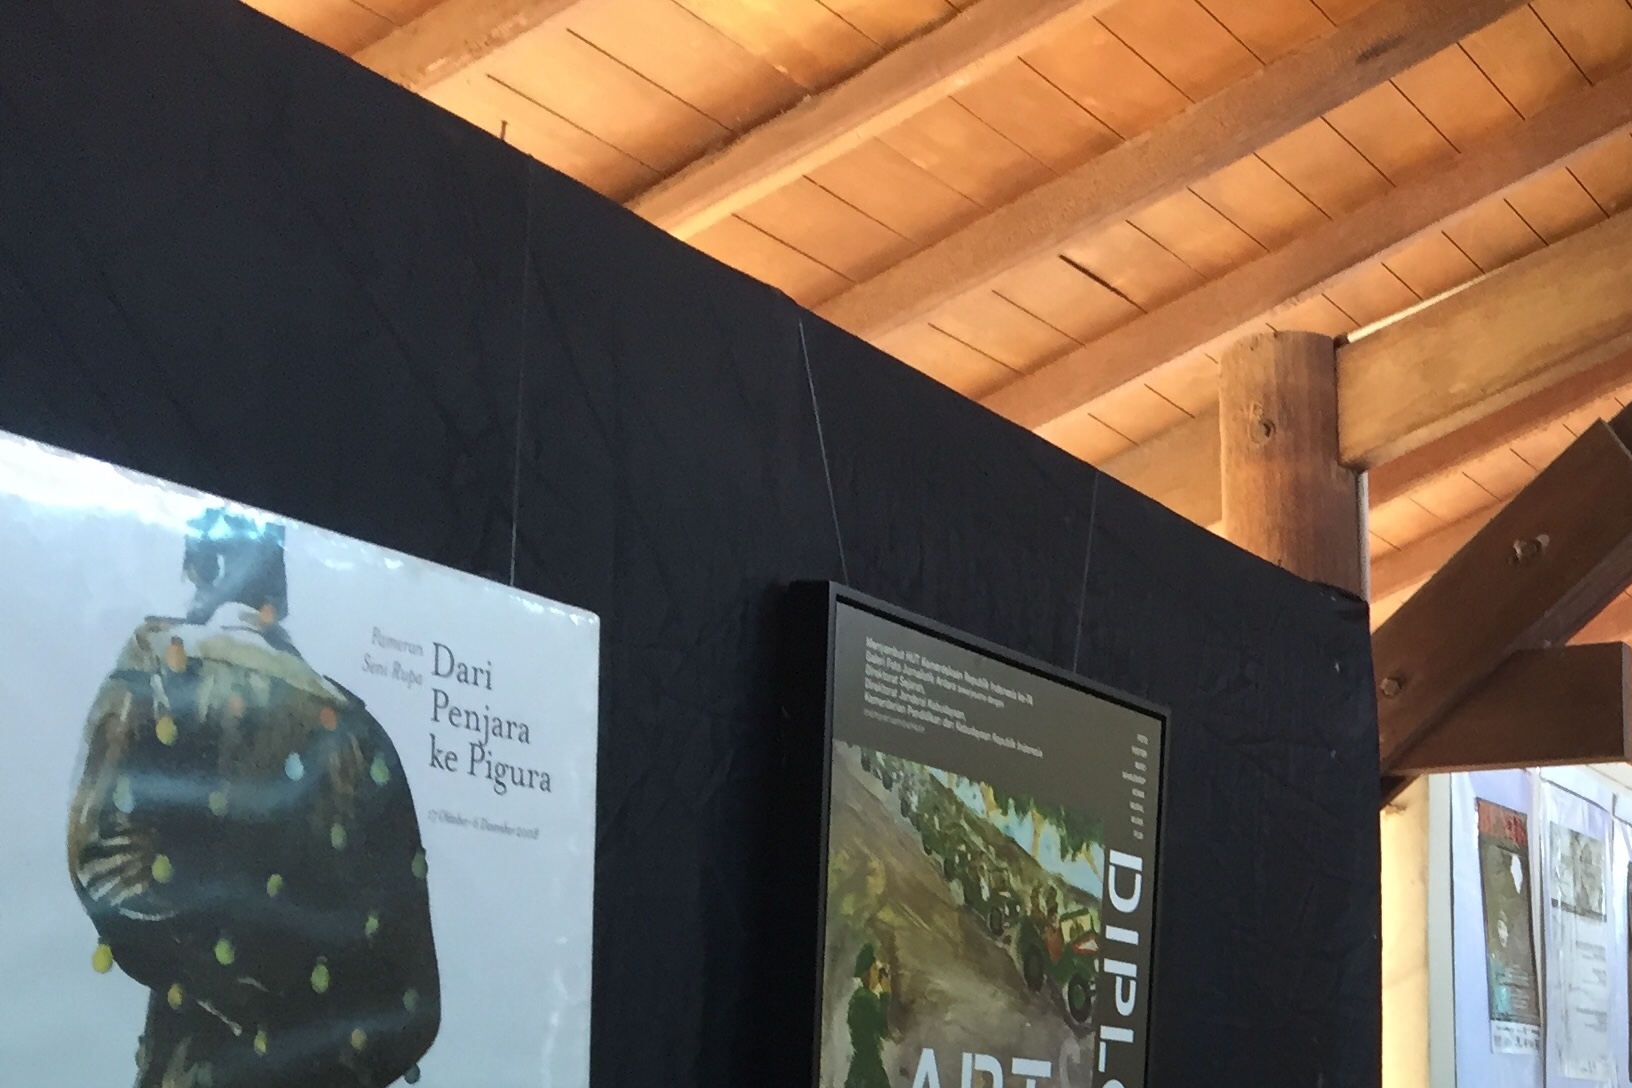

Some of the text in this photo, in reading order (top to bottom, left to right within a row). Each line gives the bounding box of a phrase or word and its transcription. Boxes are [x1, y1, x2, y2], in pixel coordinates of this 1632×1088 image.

[431, 641, 493, 691] Dari
[430, 688, 531, 747] Penjara
[428, 733, 552, 796] ke Pigura
